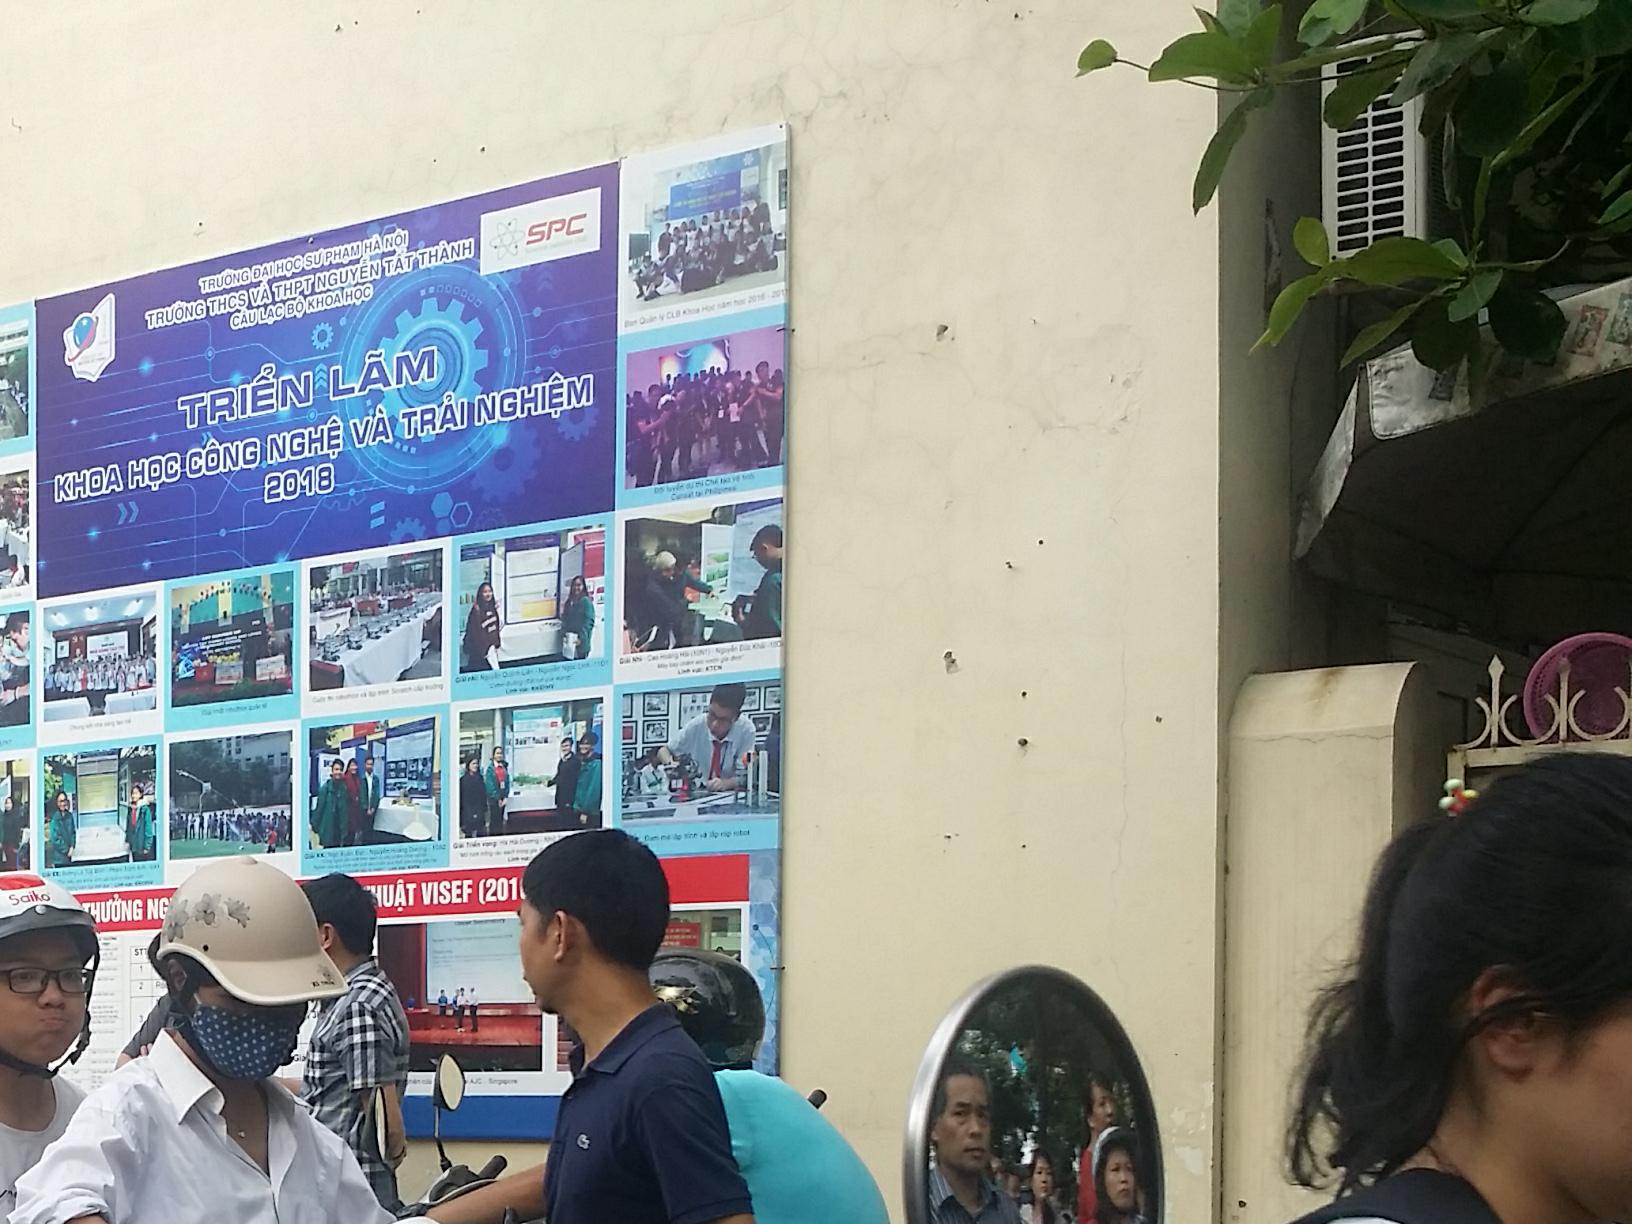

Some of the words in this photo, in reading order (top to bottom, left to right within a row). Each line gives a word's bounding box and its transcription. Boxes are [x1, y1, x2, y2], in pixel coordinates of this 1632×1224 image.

[526, 213, 587, 245] SPC
[146, 301, 205, 329] TRƯỜNG
[208, 291, 247, 316] THCS
[249, 281, 271, 306] VÀ
[274, 276, 314, 300] THPT
[316, 257, 381, 289] NGUYỄN
[383, 251, 415, 276] TẤT
[418, 238, 474, 267] THÀNH
[200, 269, 250, 293] TRƯỜNG
[253, 263, 273, 281] ĐẠI
[275, 256, 302, 277] HỌC
[304, 250, 324, 270] SƯ
[325, 243, 361, 265] PHẠM
[363, 233, 382, 254] HÀ
[384, 229, 409, 252] NỘI
[259, 306, 284, 324] LẠC
[286, 297, 305, 317] BỘ
[307, 292, 343, 313] KHOA
[344, 284, 372, 305] HỌC
[178, 363, 313, 428] TRIỂN
[329, 346, 437, 400] LÃM
[54, 465, 123, 502] KHOA
[128, 453, 181, 492] HỌC
[186, 438, 260, 478] CÔNG
[267, 416, 343, 464] NGHỆ
[351, 404, 392, 447] VÀ
[399, 395, 468, 438] TRẢI
[473, 372, 594, 427] NGHIỆM
[264, 463, 334, 503] 2018
[9, 889, 51, 906] Saiko
[82, 893, 143, 924] THƯỞNG
[147, 896, 171, 920] NG
[367, 879, 417, 912] HUẬT
[421, 879, 473, 906] VISEF
